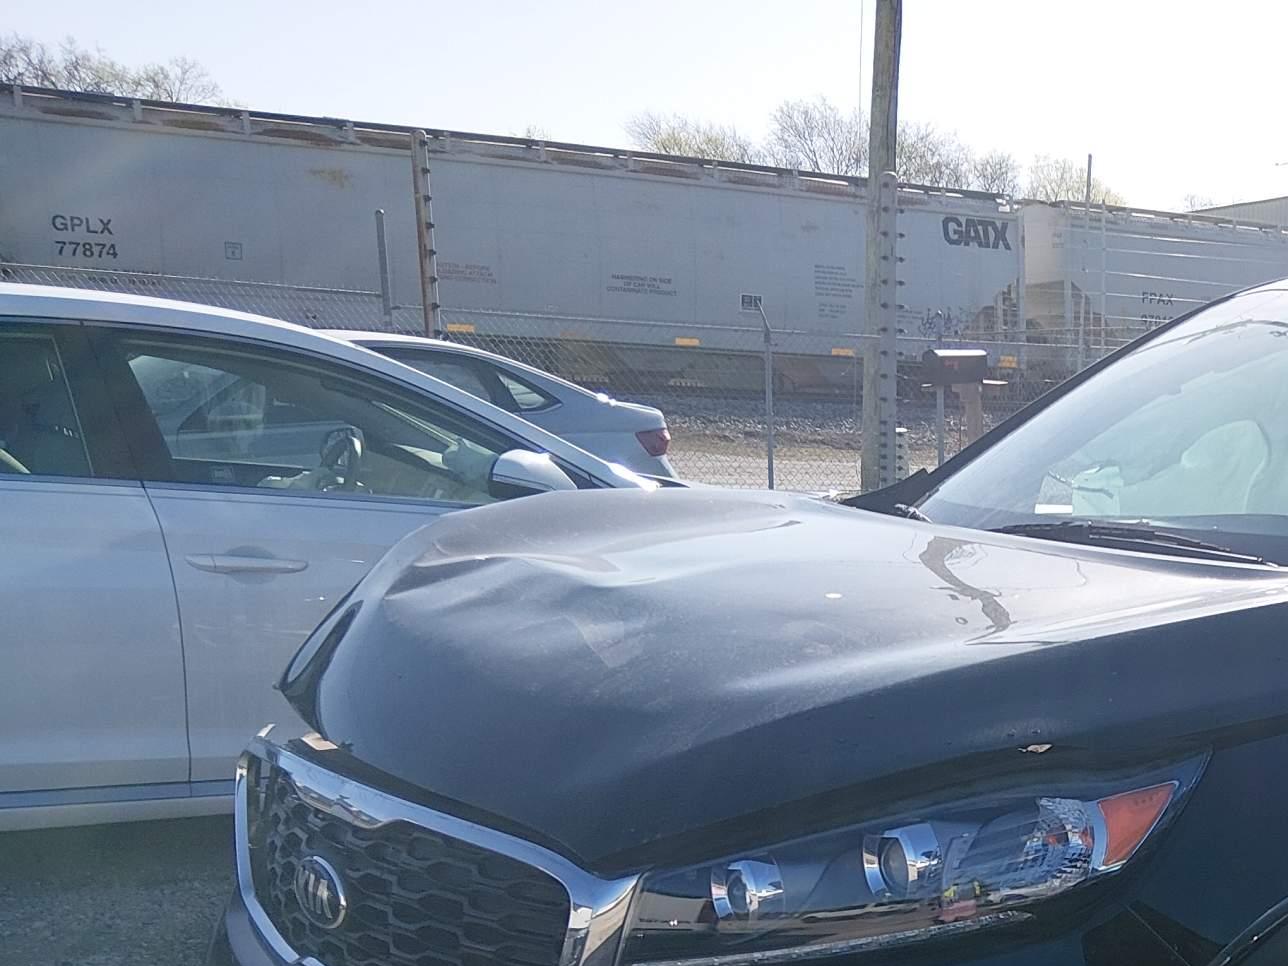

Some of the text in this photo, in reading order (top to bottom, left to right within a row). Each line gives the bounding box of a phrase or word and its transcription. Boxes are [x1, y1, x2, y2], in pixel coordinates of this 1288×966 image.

[52, 214, 113, 236] GPLX
[942, 216, 1012, 251] GATX
[54, 240, 119, 259] 77874
